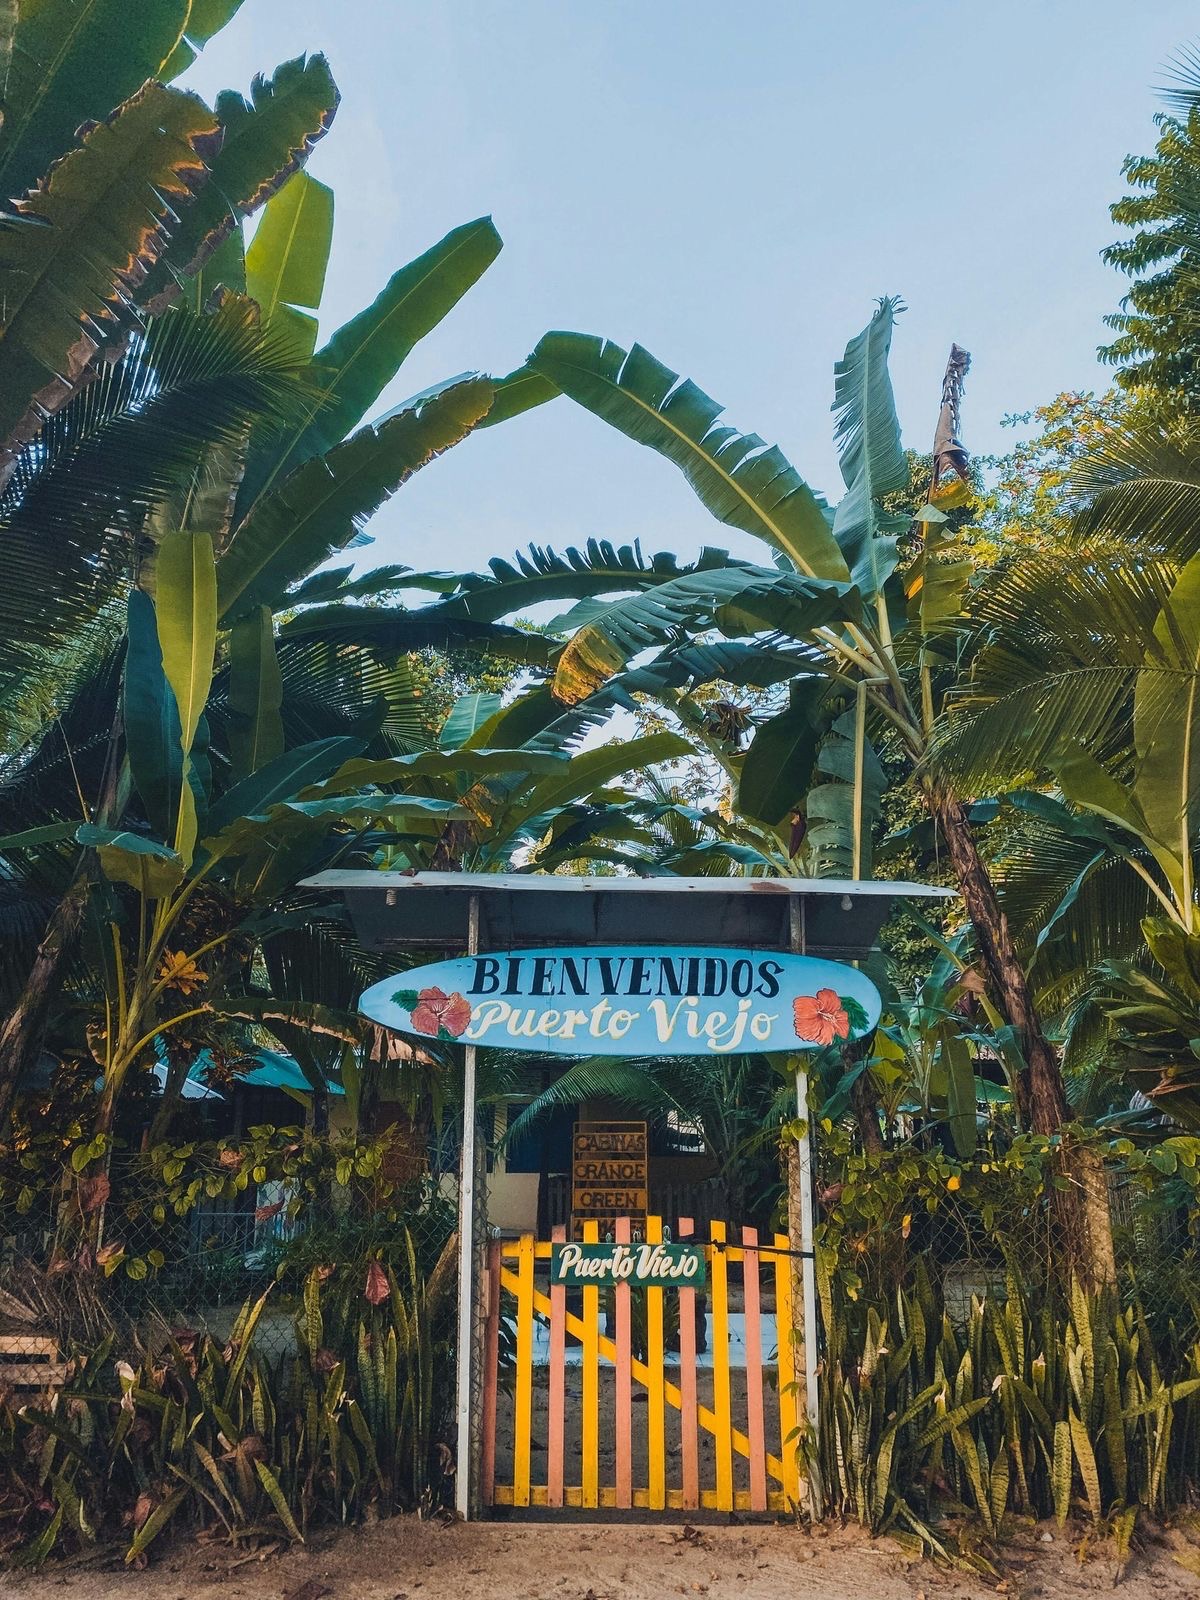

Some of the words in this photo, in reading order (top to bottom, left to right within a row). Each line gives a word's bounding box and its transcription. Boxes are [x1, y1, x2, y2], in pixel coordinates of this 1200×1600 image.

[466, 957, 785, 998] BIENVENIDOS
[465, 997, 640, 1040] Puerto
[647, 996, 779, 1051] Viejo
[558, 1244, 637, 1279] Puerto
[636, 1244, 699, 1280] Viejo
